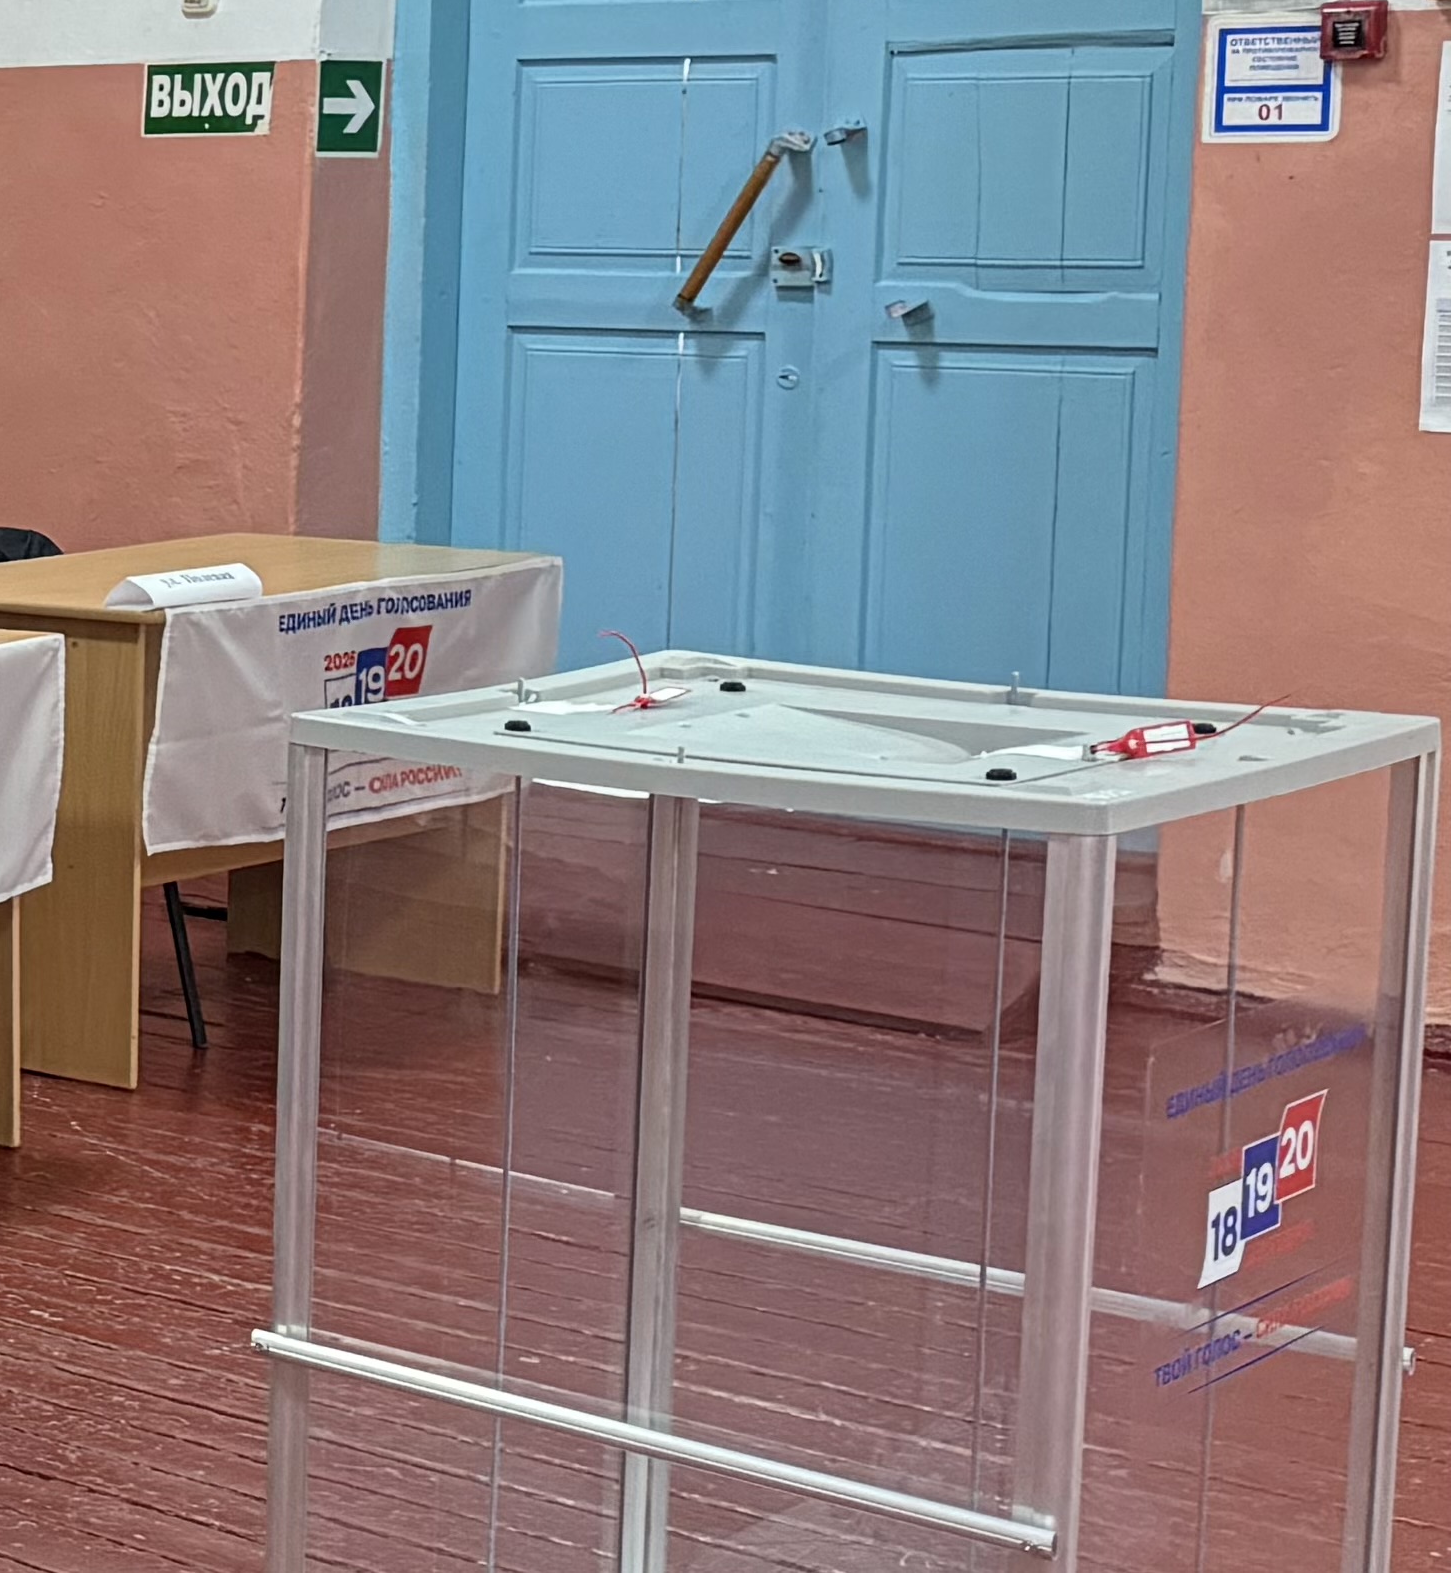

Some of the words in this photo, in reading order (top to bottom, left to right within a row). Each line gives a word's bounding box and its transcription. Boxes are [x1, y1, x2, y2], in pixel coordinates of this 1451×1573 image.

[150, 71, 272, 125] ВЫХОД
[1258, 103, 1284, 121] 01
[279, 603, 336, 634] ЕДИНЫЙ
[339, 600, 374, 626] ДЕНЬ
[376, 589, 472, 617] ГОЛОСОВАНИЯ
[358, 665, 385, 706] 19
[388, 642, 424, 682] 20
[1211, 1205, 1238, 1262] 18
[1245, 1161, 1274, 1218] 19
[1279, 1119, 1314, 1179] 20
[1155, 1347, 1192, 1387] ТВОЙ
